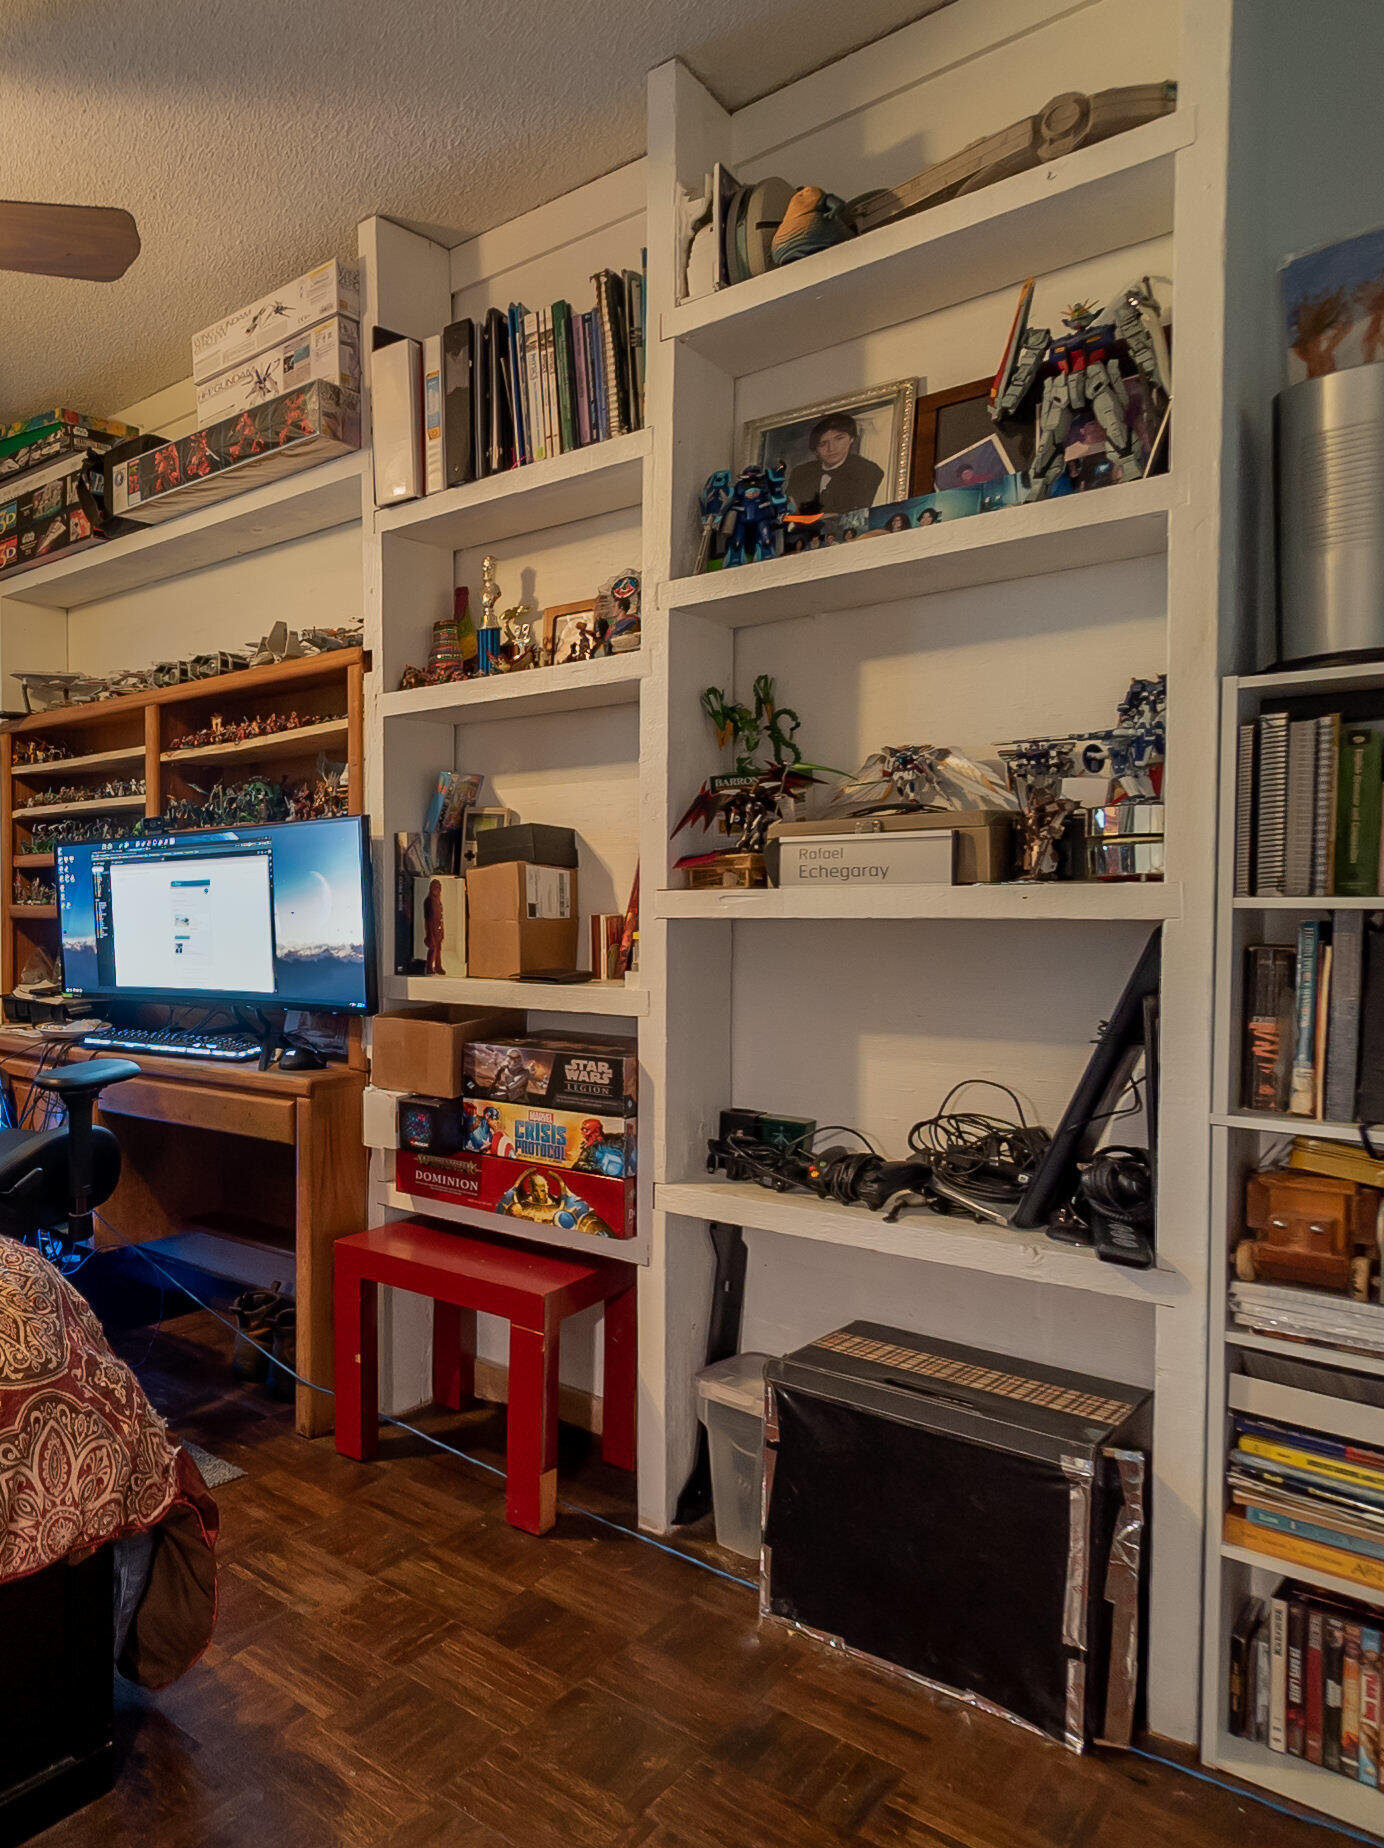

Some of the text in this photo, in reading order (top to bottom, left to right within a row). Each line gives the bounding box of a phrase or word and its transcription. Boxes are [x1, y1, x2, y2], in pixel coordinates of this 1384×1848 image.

[799, 847, 844, 860] Rafael
[799, 864, 890, 881] Echegaray
[565, 1059, 613, 1074] STAR
[565, 1069, 613, 1084] WARS
[567, 1083, 609, 1095] LEGION
[514, 1120, 567, 1146] CRISIS
[514, 1140, 567, 1161] PROTOCOL
[415, 1169, 479, 1191] DOMINION
